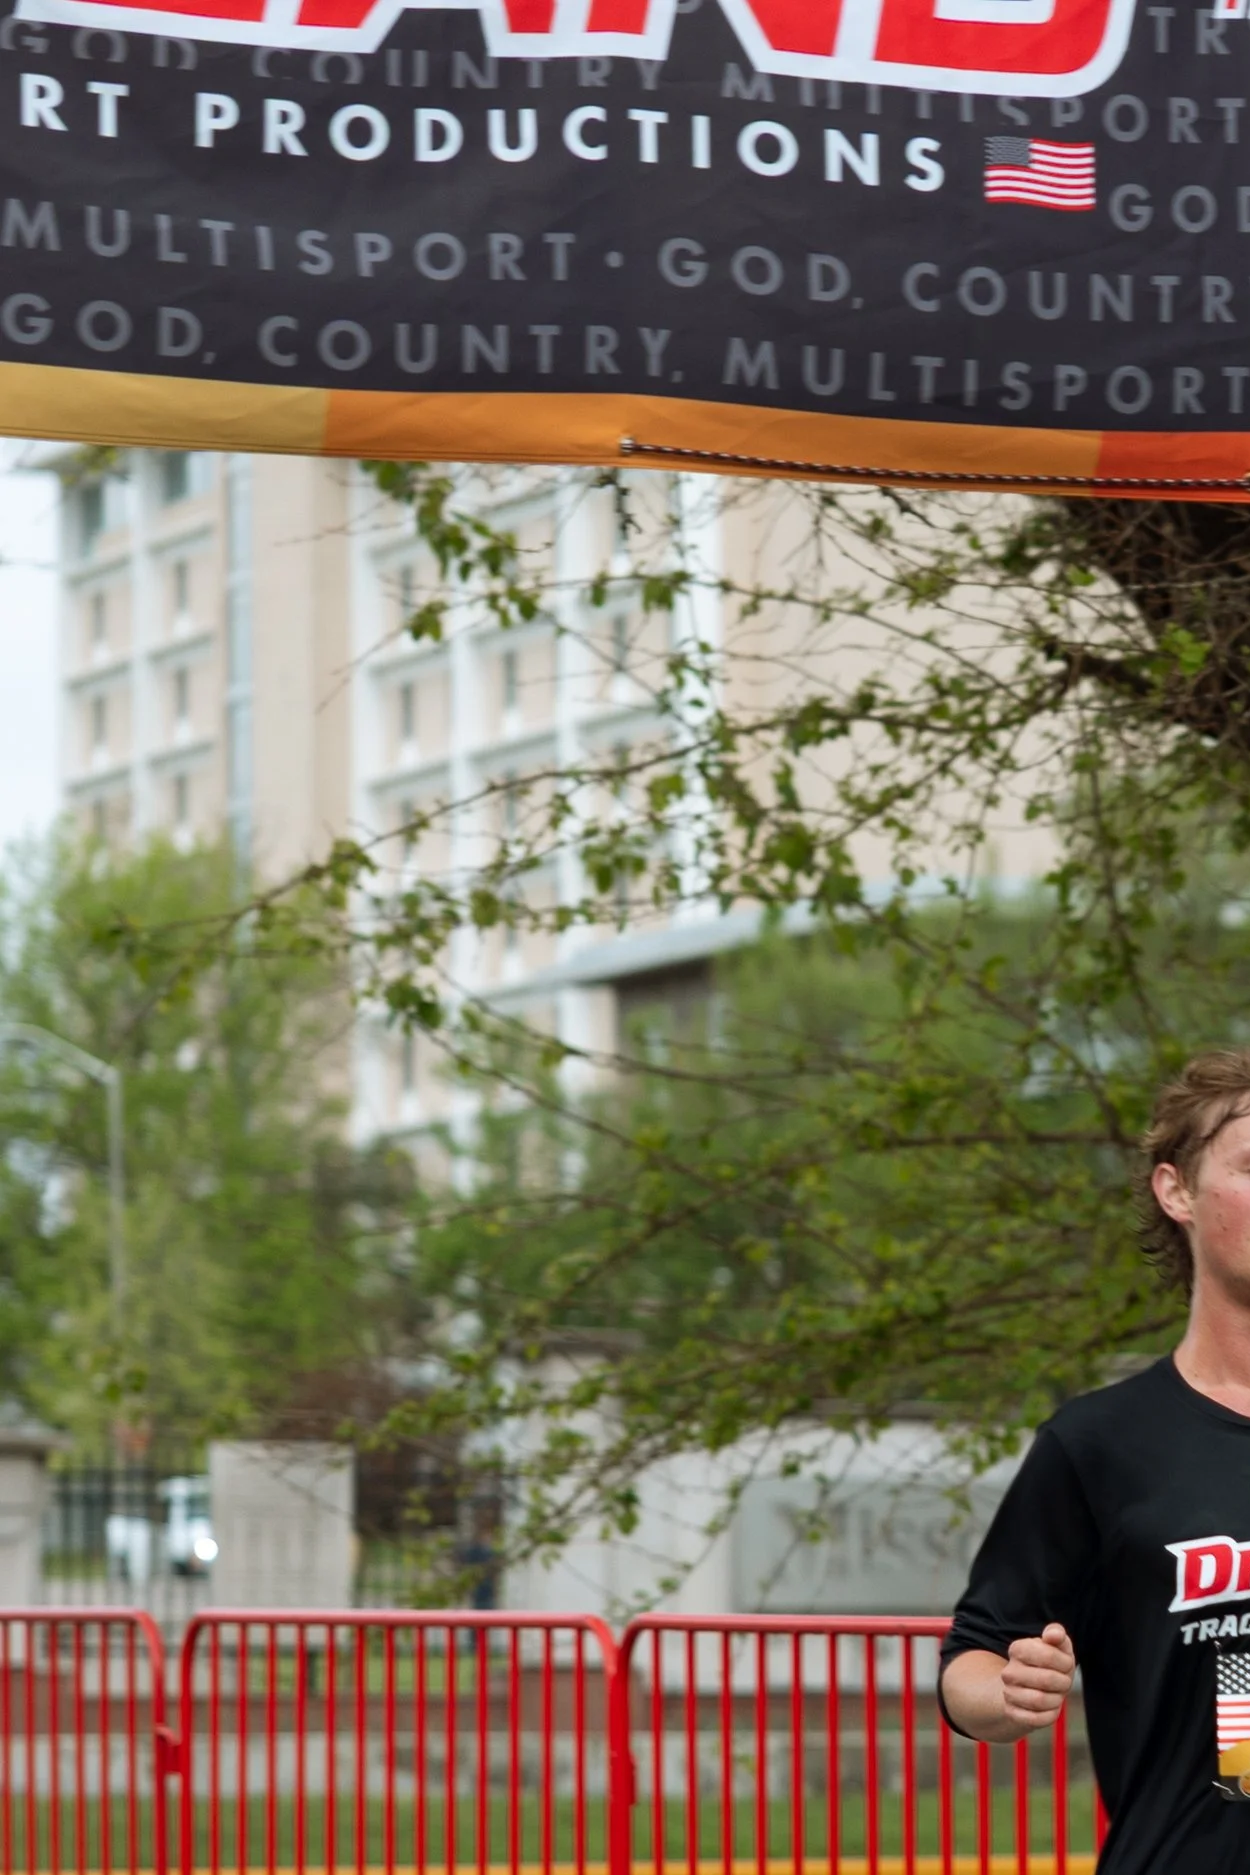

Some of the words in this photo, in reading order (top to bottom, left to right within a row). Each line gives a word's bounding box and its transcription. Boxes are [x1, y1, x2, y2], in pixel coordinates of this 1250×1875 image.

[19, 73, 130, 138] RT
[194, 91, 946, 193] PRODUCTIONS
[1, 199, 578, 282] MULTISPORT
[657, 237, 865, 310] GOD,
[1, 292, 218, 365] GOD,
[257, 314, 685, 384] COUNTRY,
